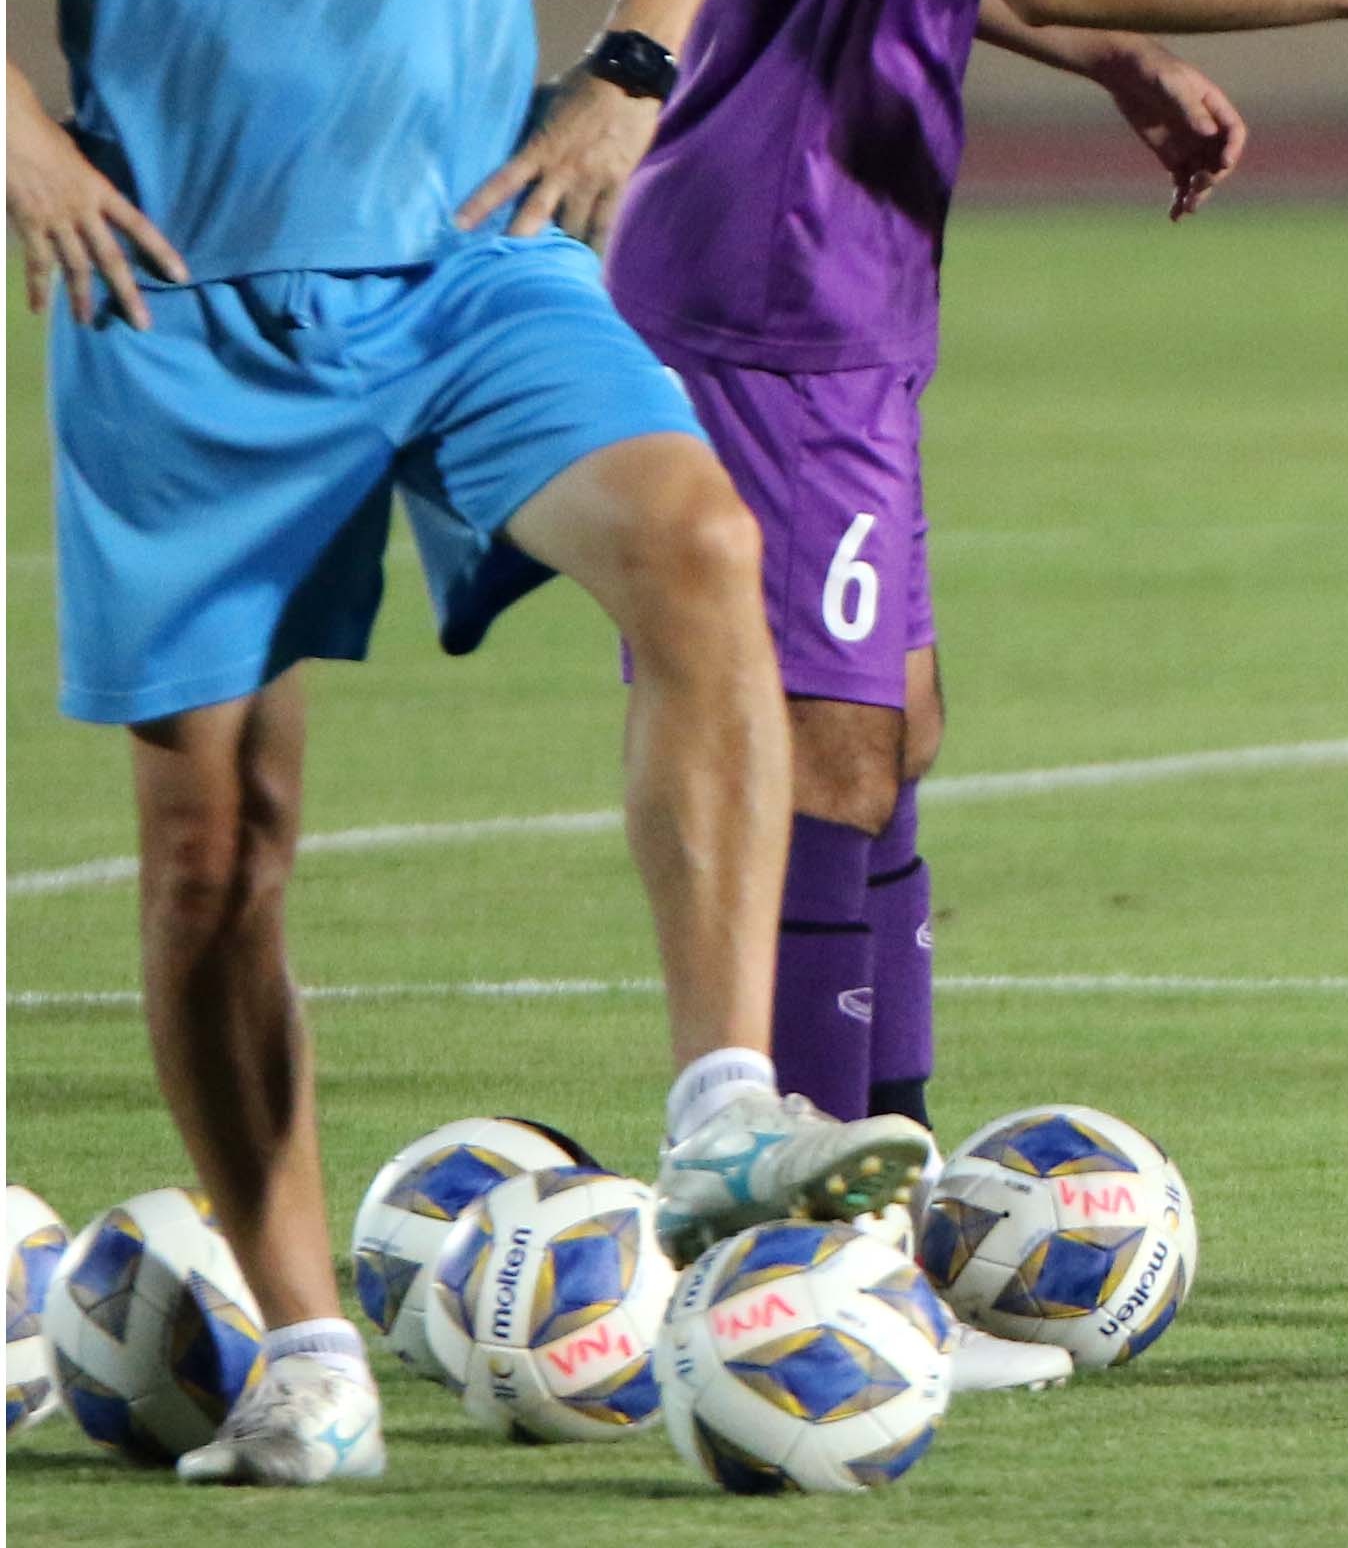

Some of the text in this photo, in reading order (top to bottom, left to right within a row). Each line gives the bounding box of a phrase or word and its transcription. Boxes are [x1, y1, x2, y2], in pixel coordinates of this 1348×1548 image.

[821, 512, 879, 642] 6
[491, 1226, 533, 1339] molten
[1098, 1240, 1169, 1337] molten
